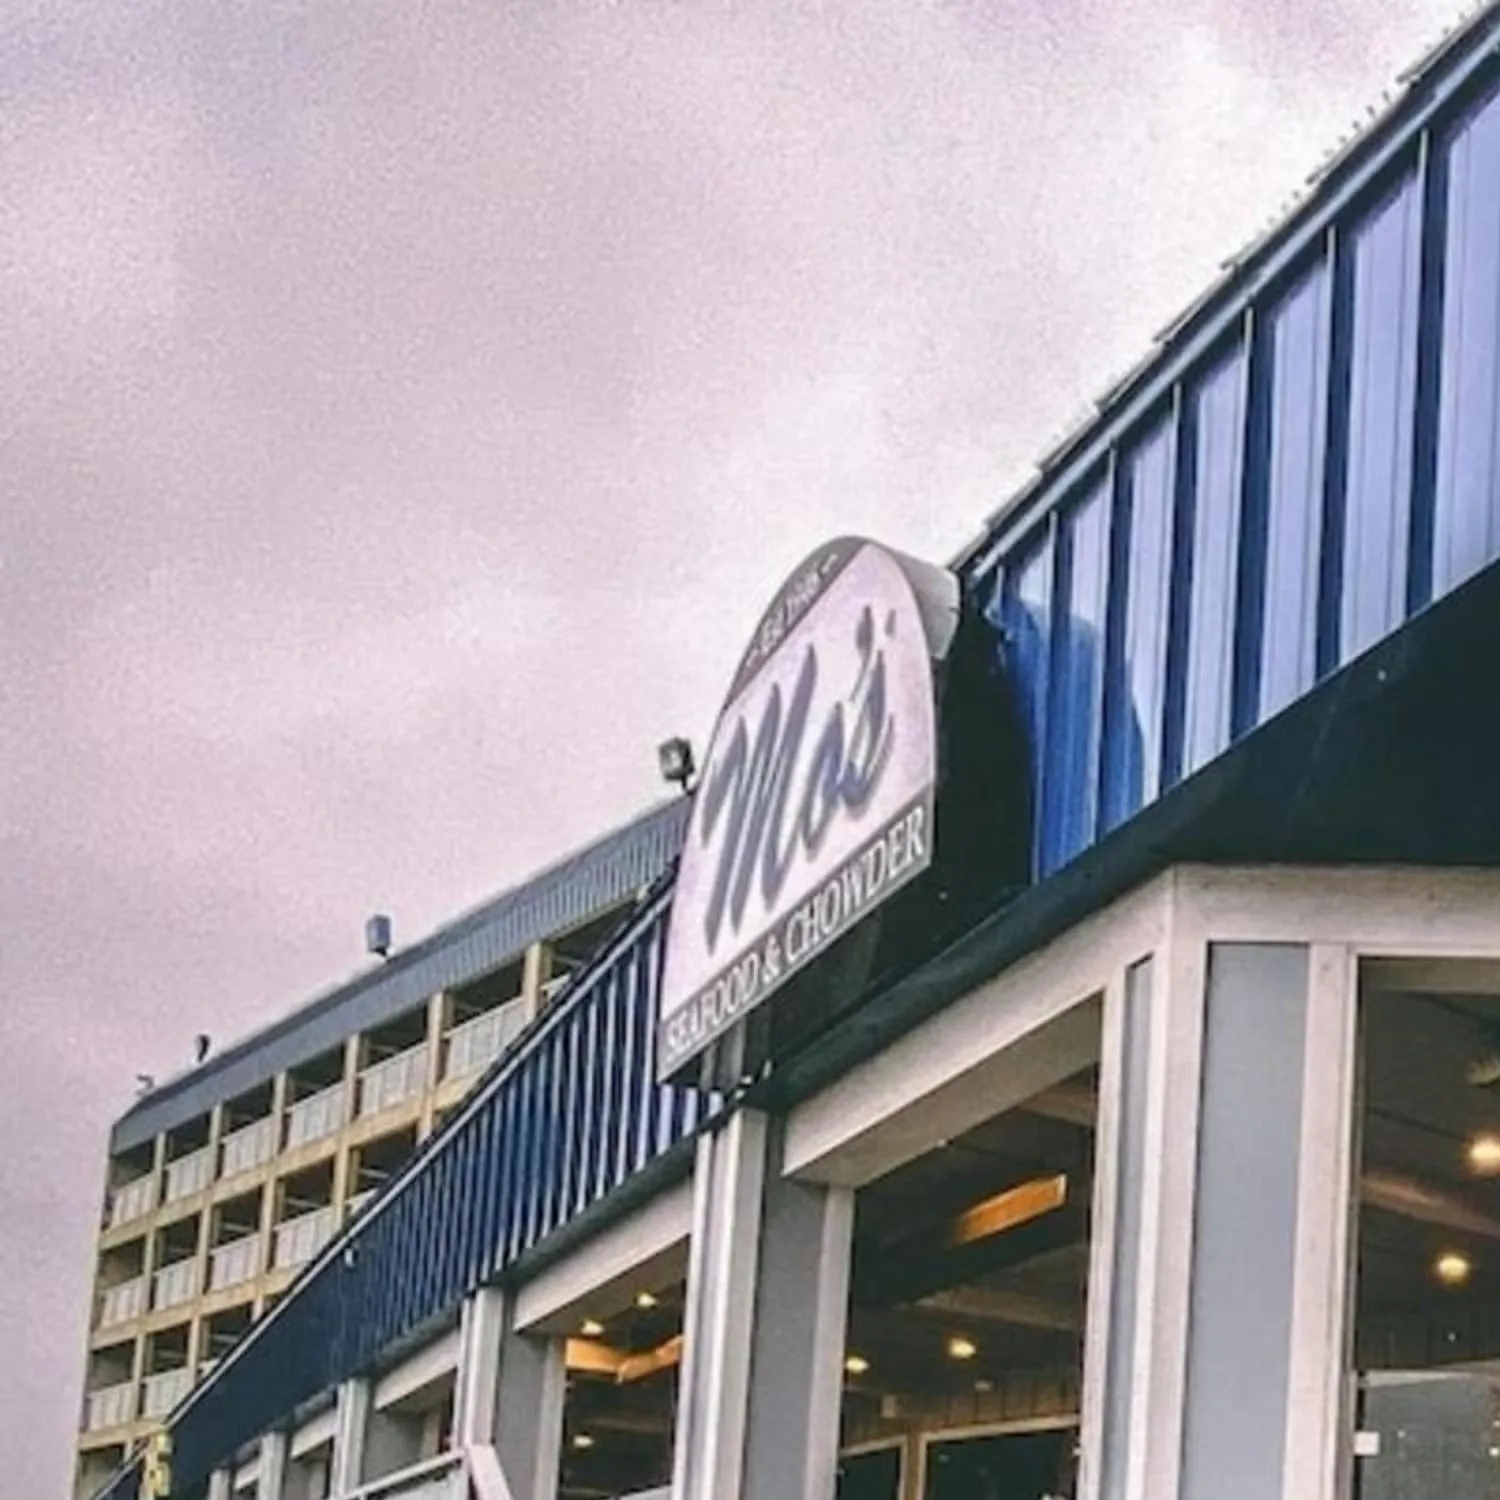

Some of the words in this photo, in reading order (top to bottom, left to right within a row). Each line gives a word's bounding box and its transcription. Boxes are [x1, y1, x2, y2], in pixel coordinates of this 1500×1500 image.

[664, 954, 761, 1057] SEAFOOD
[762, 932, 782, 979] &
[784, 805, 927, 965] CHOWDER
